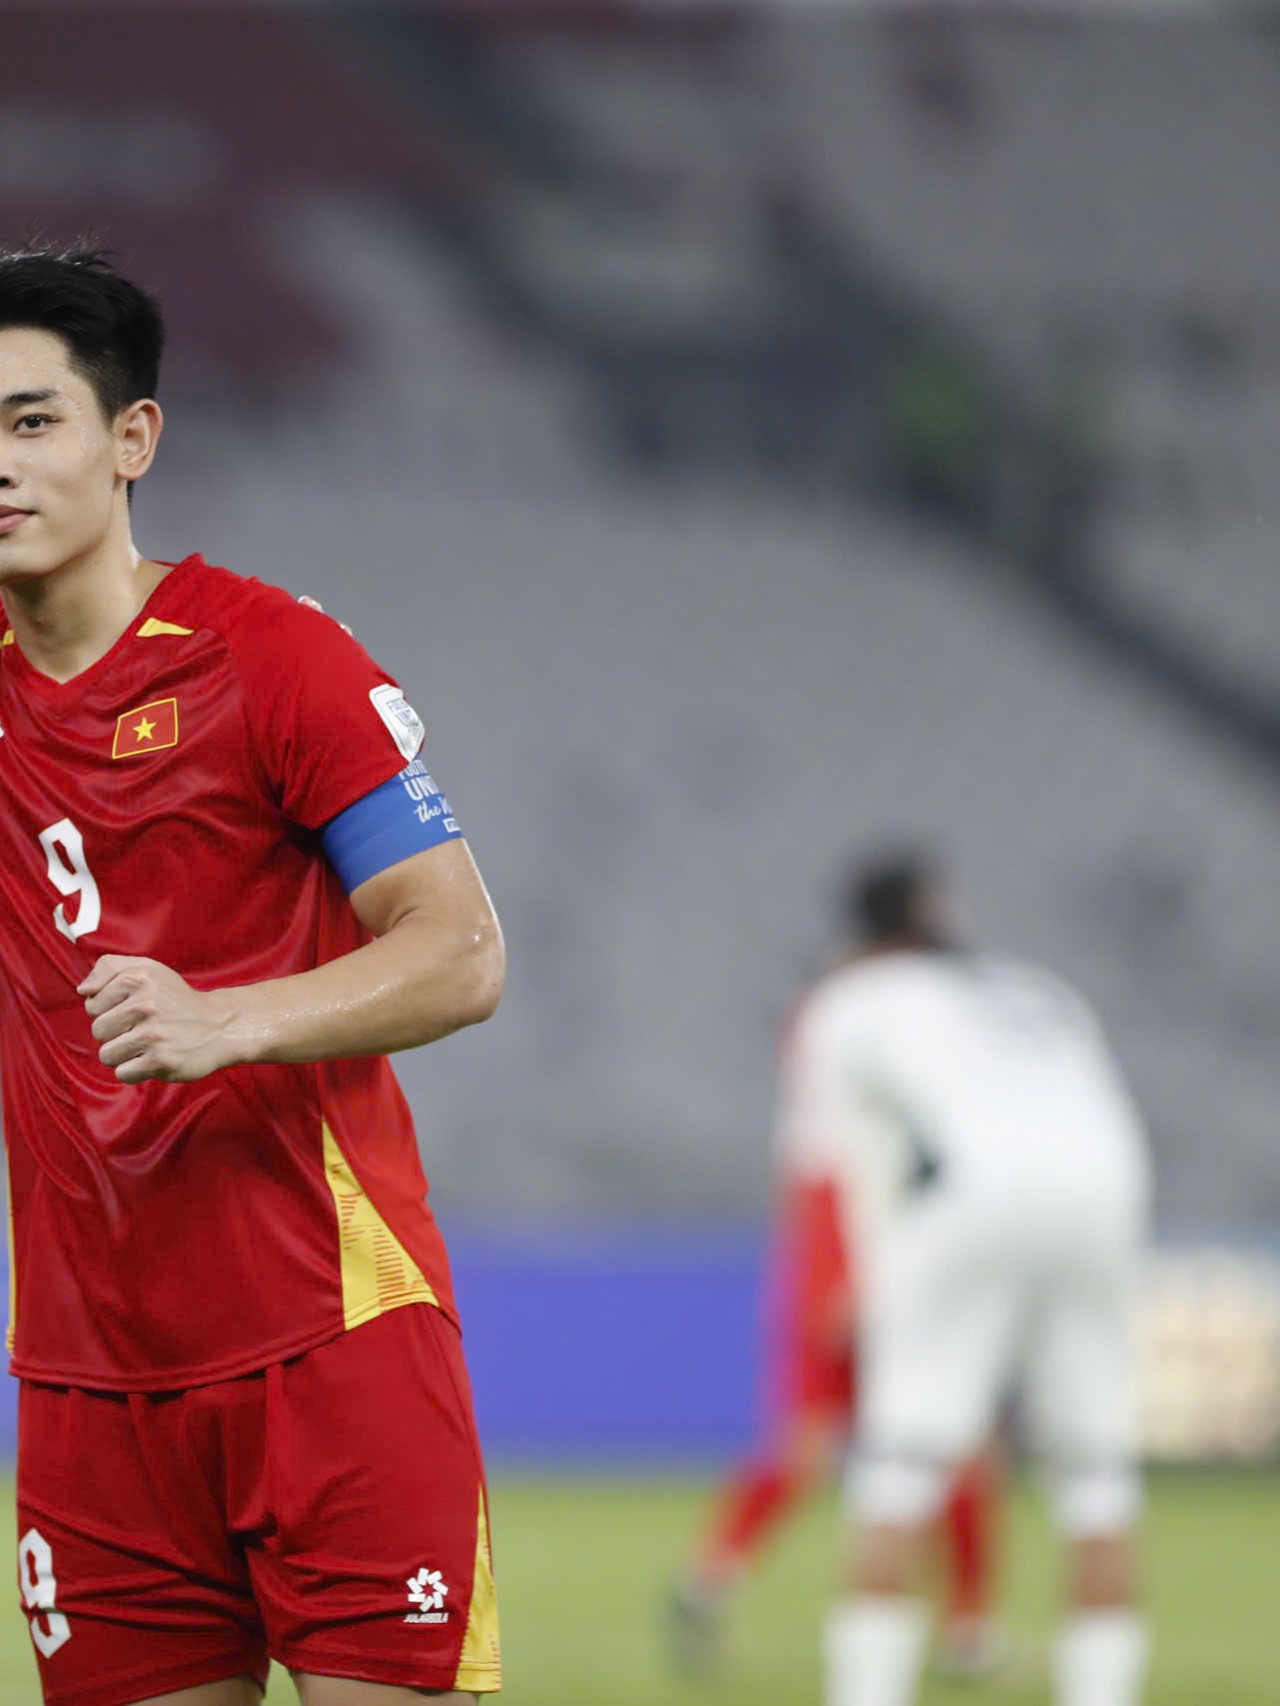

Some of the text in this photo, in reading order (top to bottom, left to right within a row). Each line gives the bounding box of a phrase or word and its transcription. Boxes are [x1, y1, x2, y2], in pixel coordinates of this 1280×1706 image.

[413, 801, 441, 823] the
[39, 819, 100, 942] 9
[18, 1529, 71, 1658] 9
